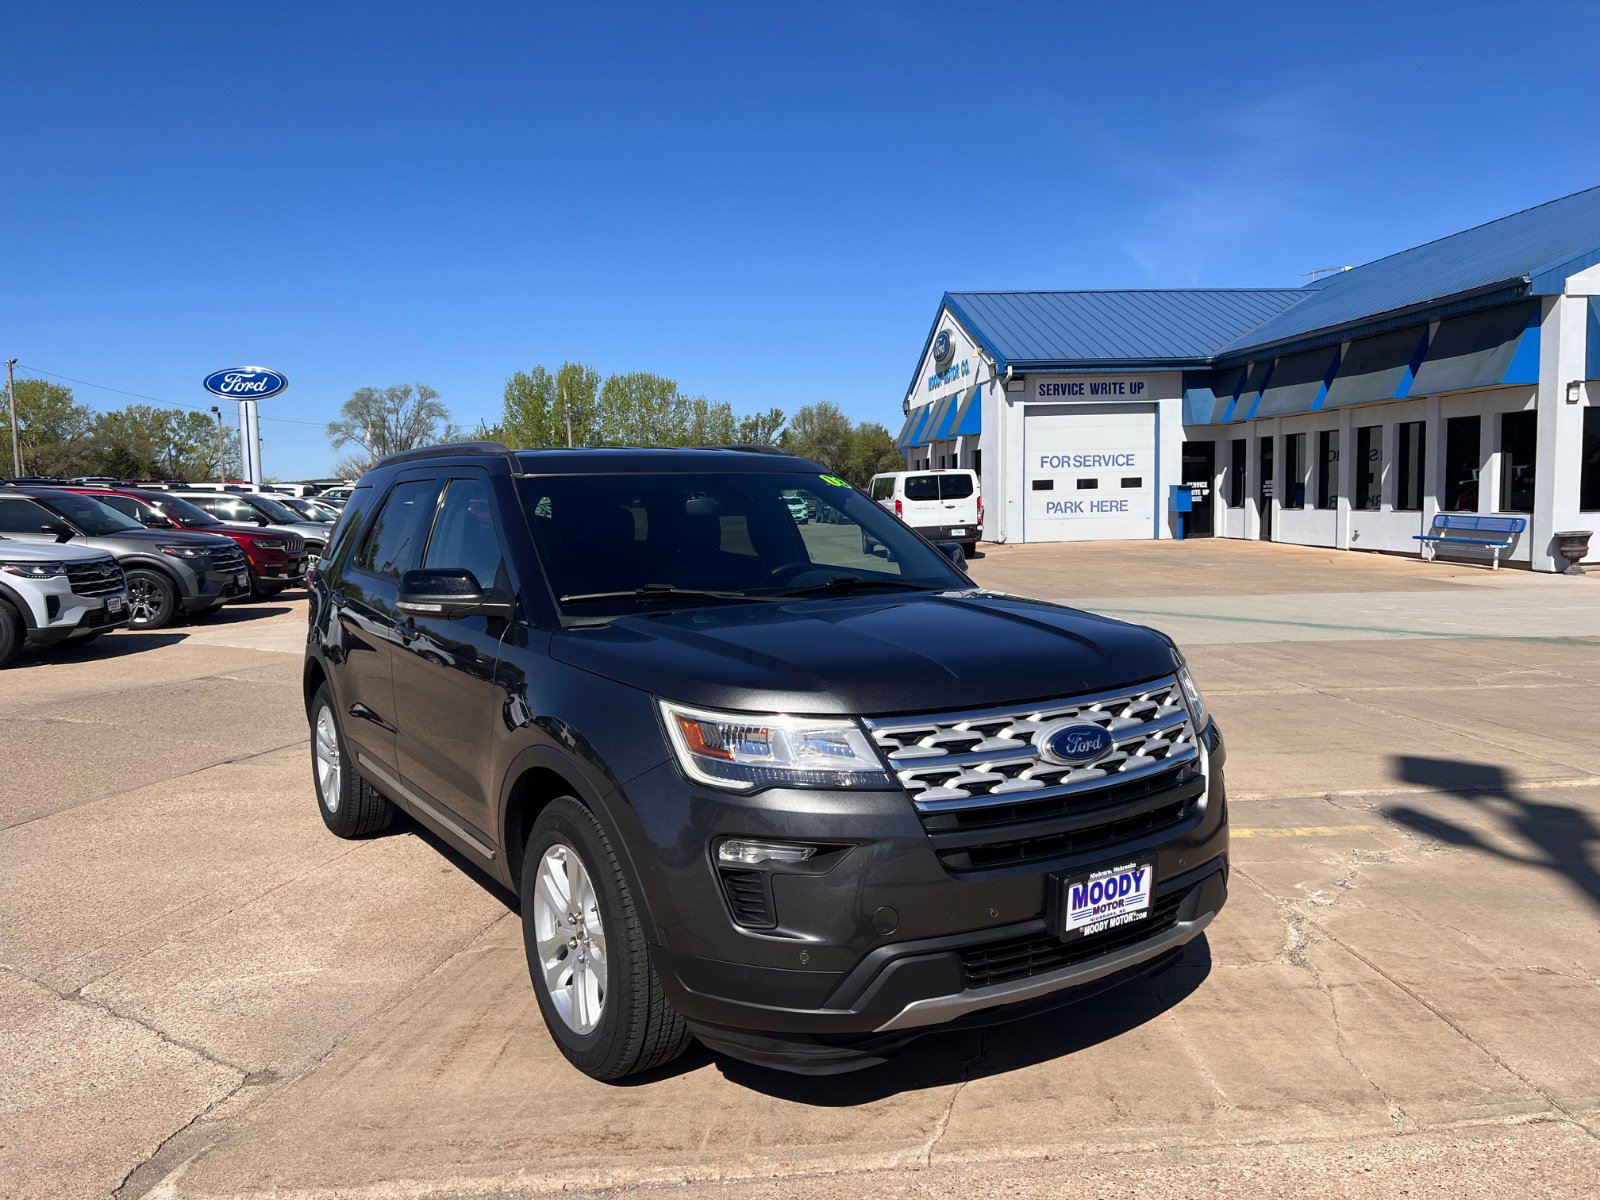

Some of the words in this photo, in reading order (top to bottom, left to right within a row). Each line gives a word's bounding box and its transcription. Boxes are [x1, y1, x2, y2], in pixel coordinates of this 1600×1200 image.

[220, 373, 268, 392] Ford
[1039, 383, 1085, 396] SERVICE
[1090, 382, 1125, 395] WRITE
[1129, 382, 1144, 395] UP
[1041, 455, 1071, 468] FOR
[1073, 454, 1135, 468] SERVICE
[1046, 501, 1084, 514] PARK
[1090, 500, 1128, 513] HERE
[1066, 731, 1103, 754] Ford
[1072, 869, 1145, 911] MOODY
[1093, 899, 1124, 915] MOTOR
[1084, 920, 1109, 936] MOODY
